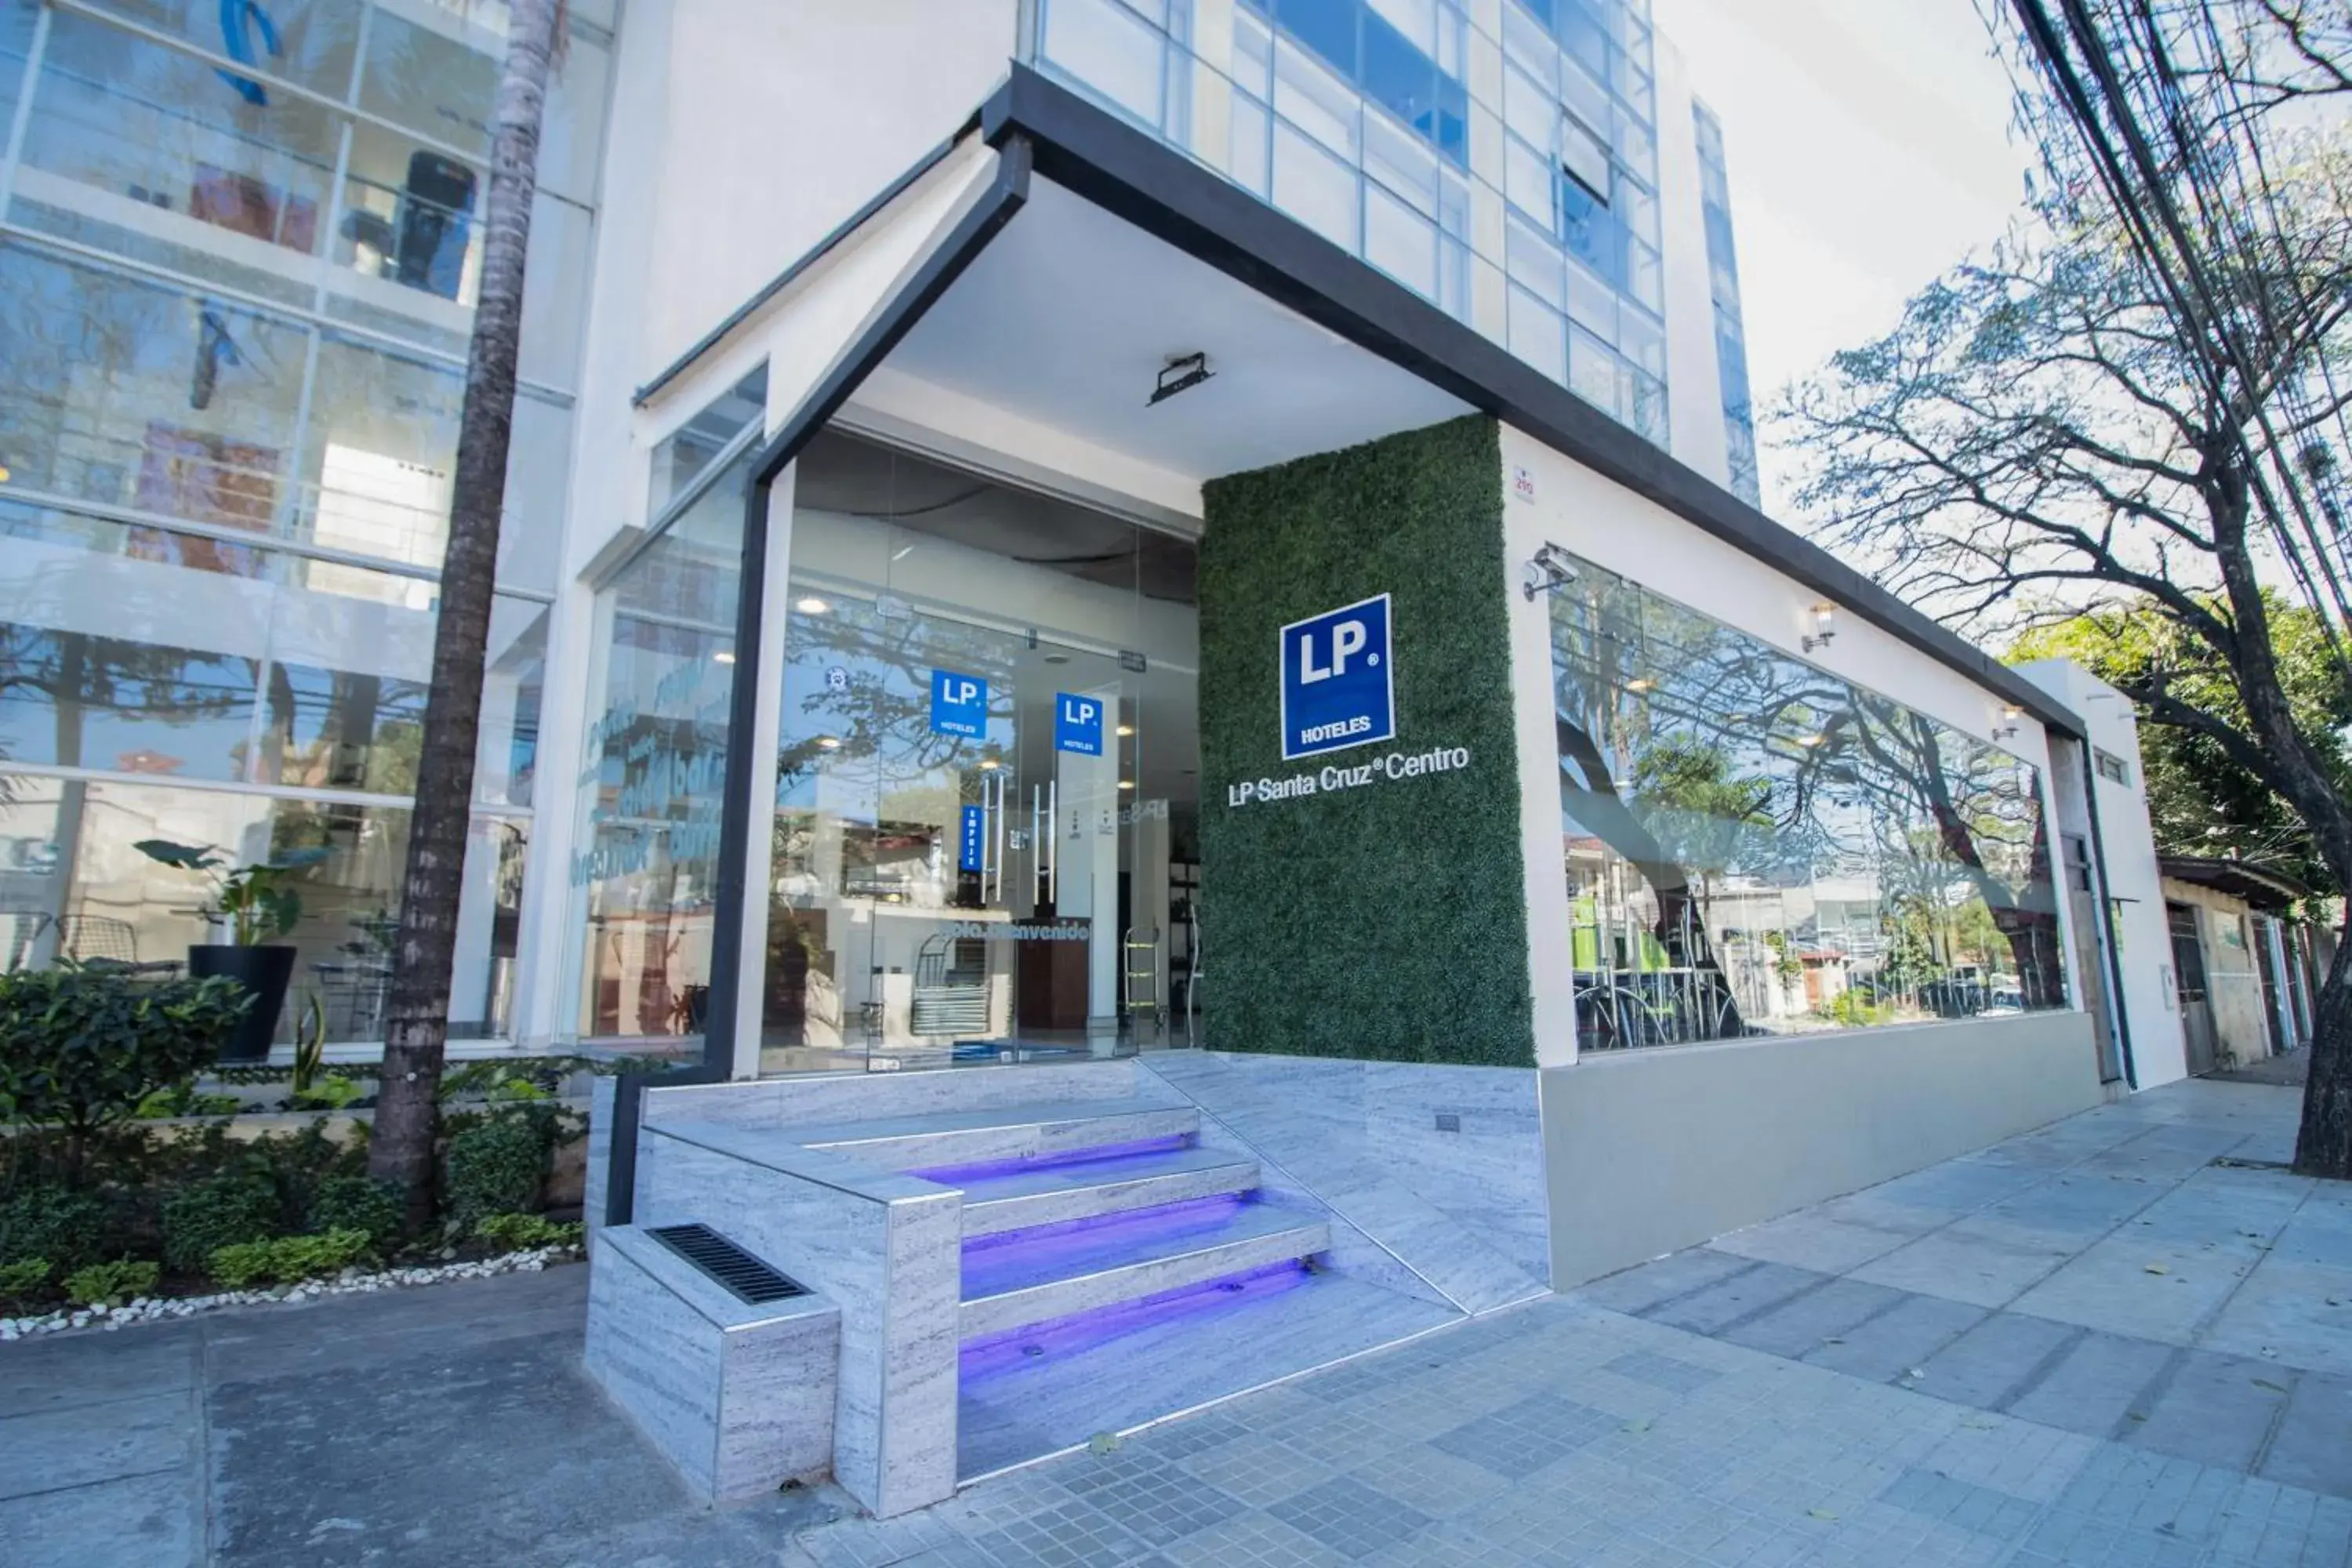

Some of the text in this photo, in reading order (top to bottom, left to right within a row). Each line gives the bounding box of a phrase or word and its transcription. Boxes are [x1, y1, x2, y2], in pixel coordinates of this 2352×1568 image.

[1301, 715, 1371, 745] HOTELES
[1228, 782, 1254, 808] LP
[1257, 773, 1317, 803] Santa
[1385, 746, 1469, 780] Centro
